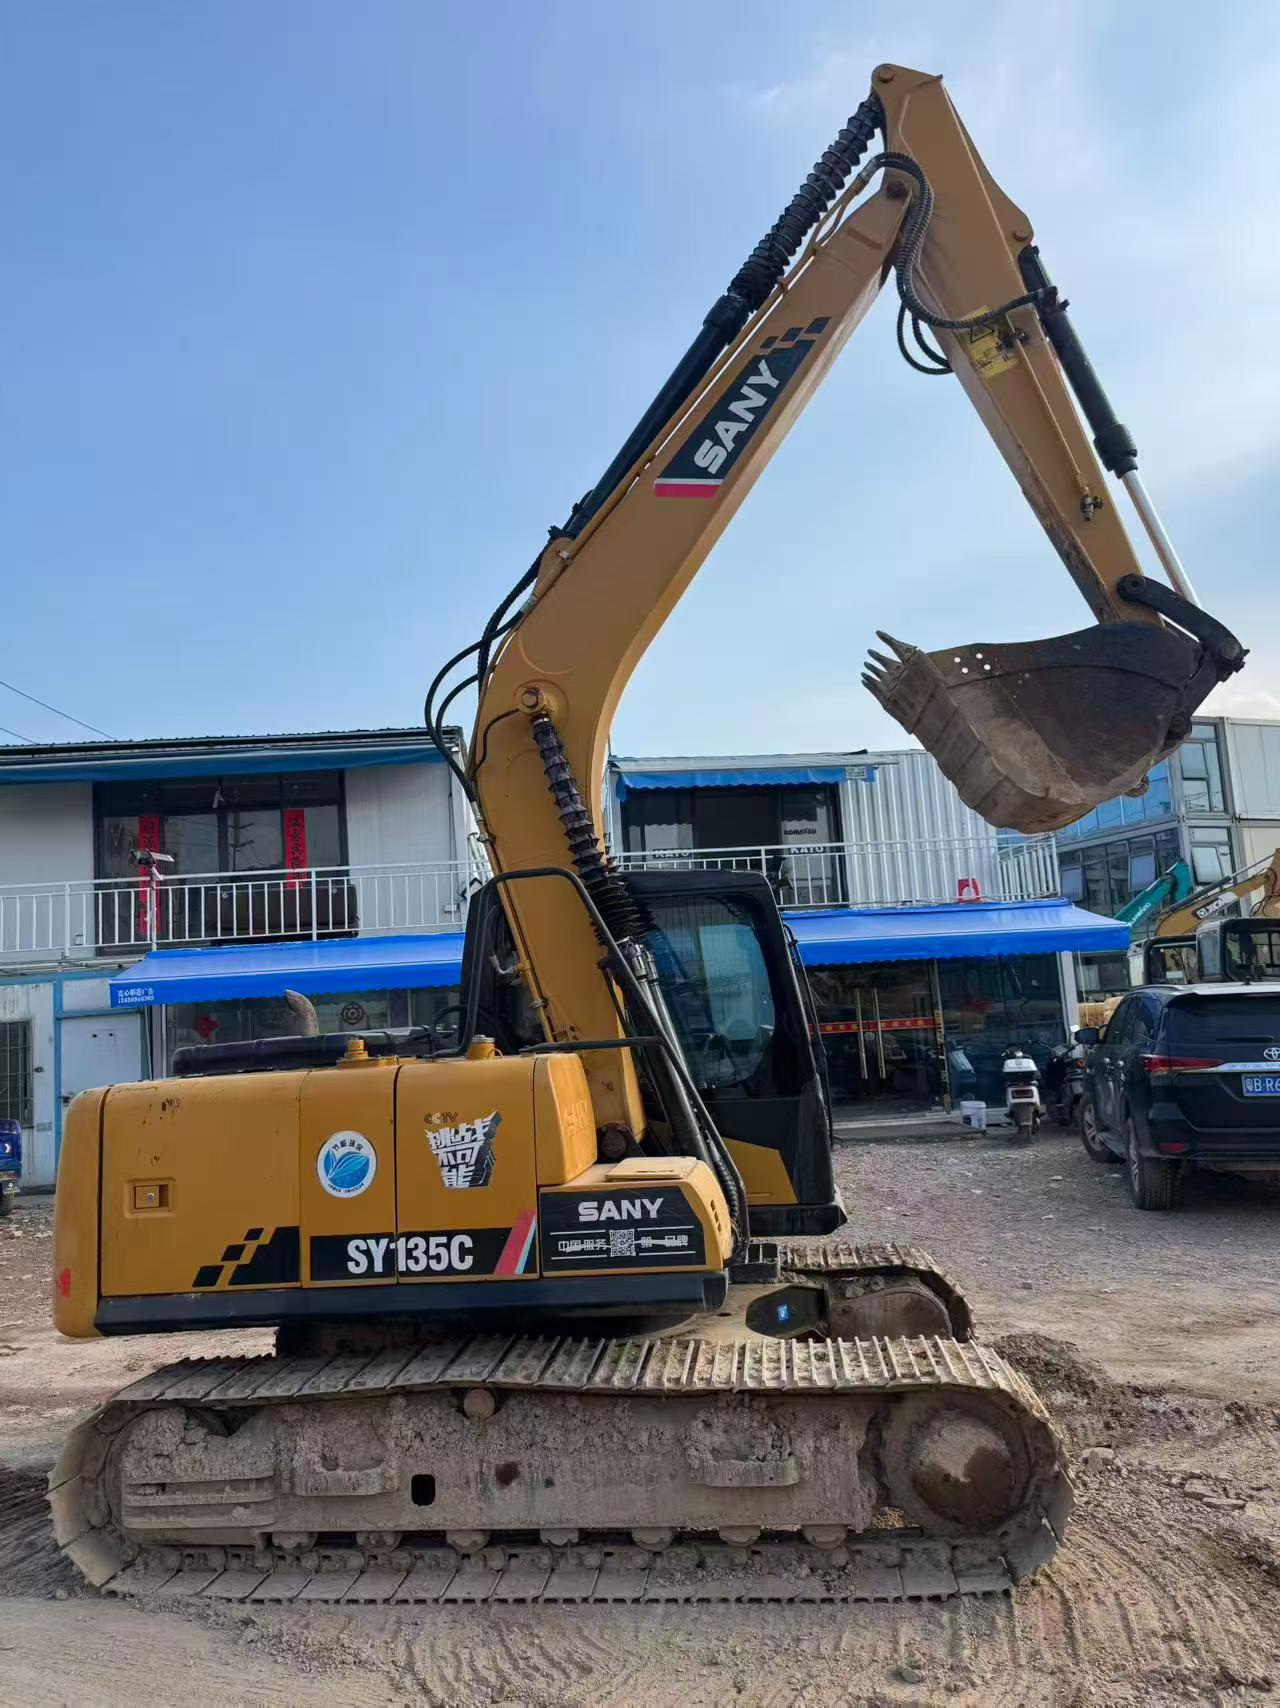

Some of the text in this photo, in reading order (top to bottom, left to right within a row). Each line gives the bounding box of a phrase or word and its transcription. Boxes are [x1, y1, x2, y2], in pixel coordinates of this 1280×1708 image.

[694, 358, 780, 475] SANY
[424, 1112, 459, 1124] CCTV
[425, 1110, 498, 1150] 挑战
[432, 1141, 485, 1167] 不可
[441, 1164, 476, 1188] 能
[578, 1198, 664, 1222] SANY
[346, 1235, 474, 1274] SY135C
